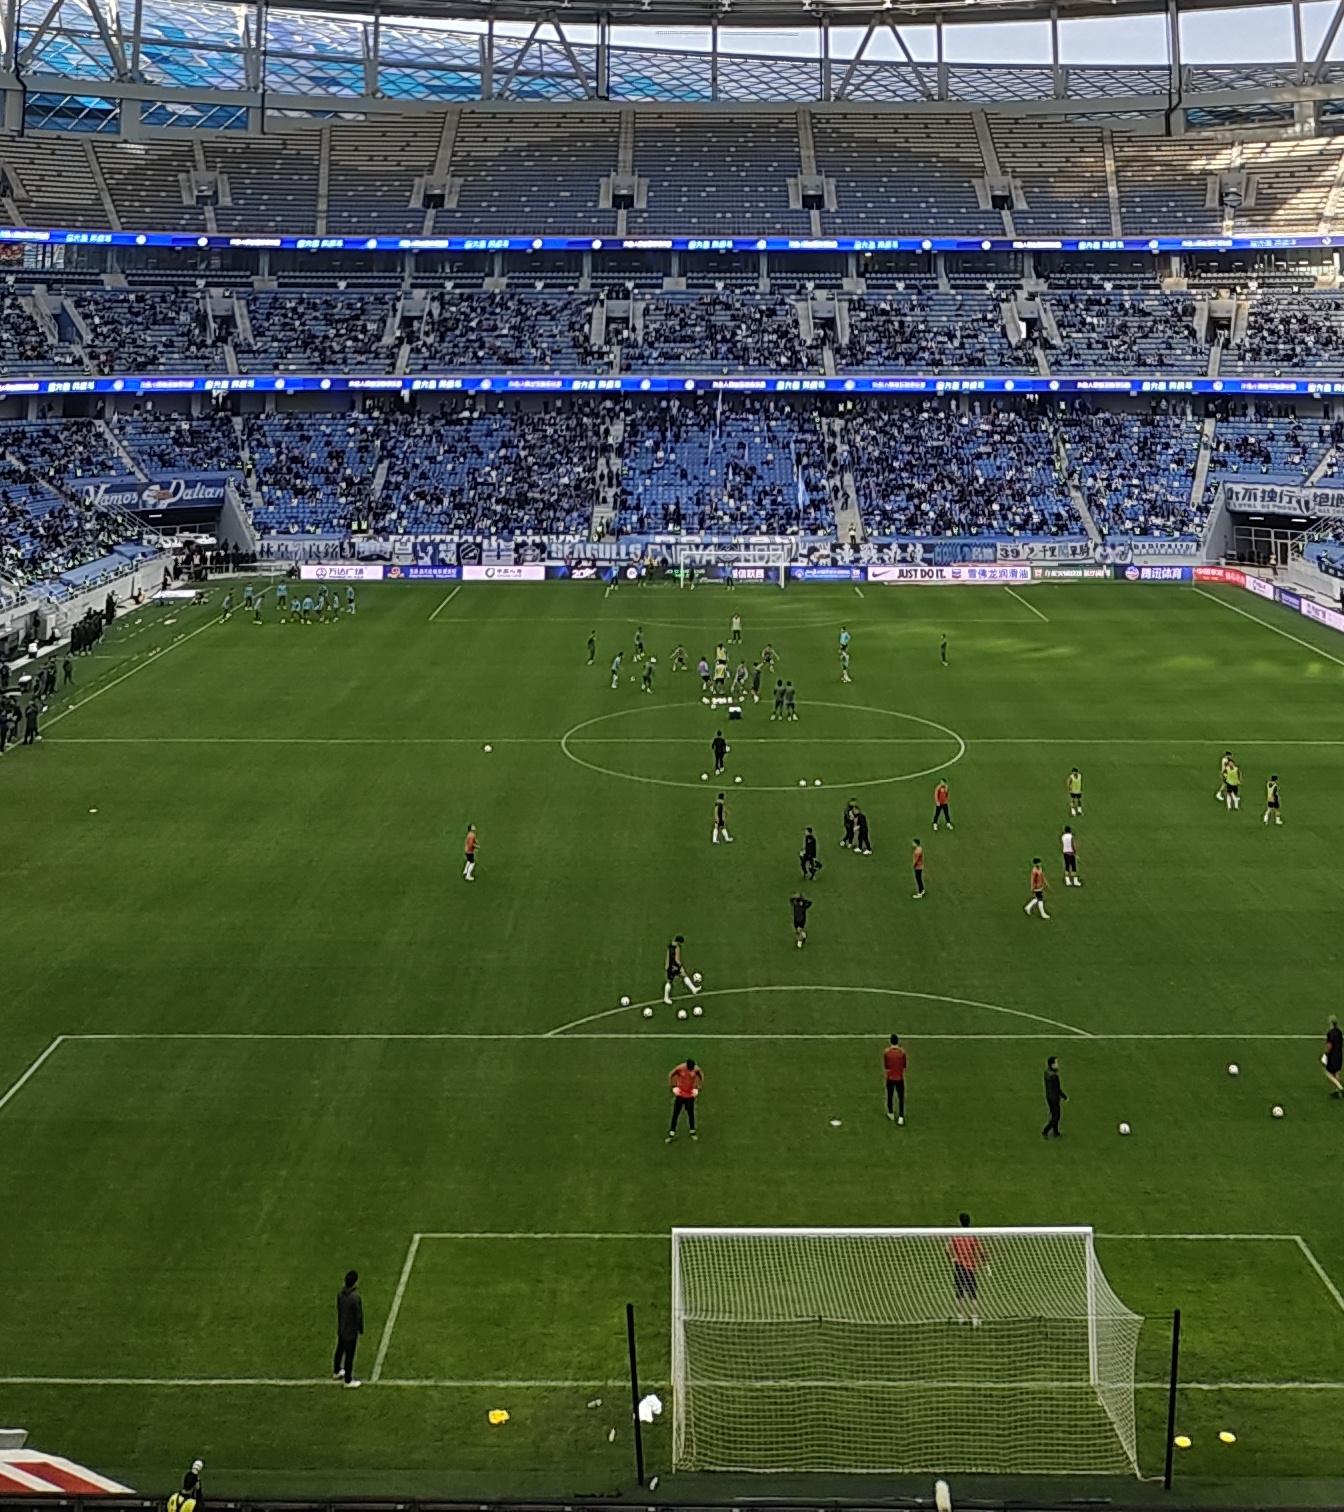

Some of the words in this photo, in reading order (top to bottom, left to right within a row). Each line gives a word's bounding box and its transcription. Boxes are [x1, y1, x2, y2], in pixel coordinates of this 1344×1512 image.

[85, 483, 139, 507] Vamos
[161, 479, 225, 508] Dalian
[551, 543, 642, 561] SEAGULLS
[897, 569, 919, 580] JUST
[920, 569, 934, 580] DO
[935, 569, 947, 580] IT.
[1141, 567, 1182, 580] 腾讯体育
